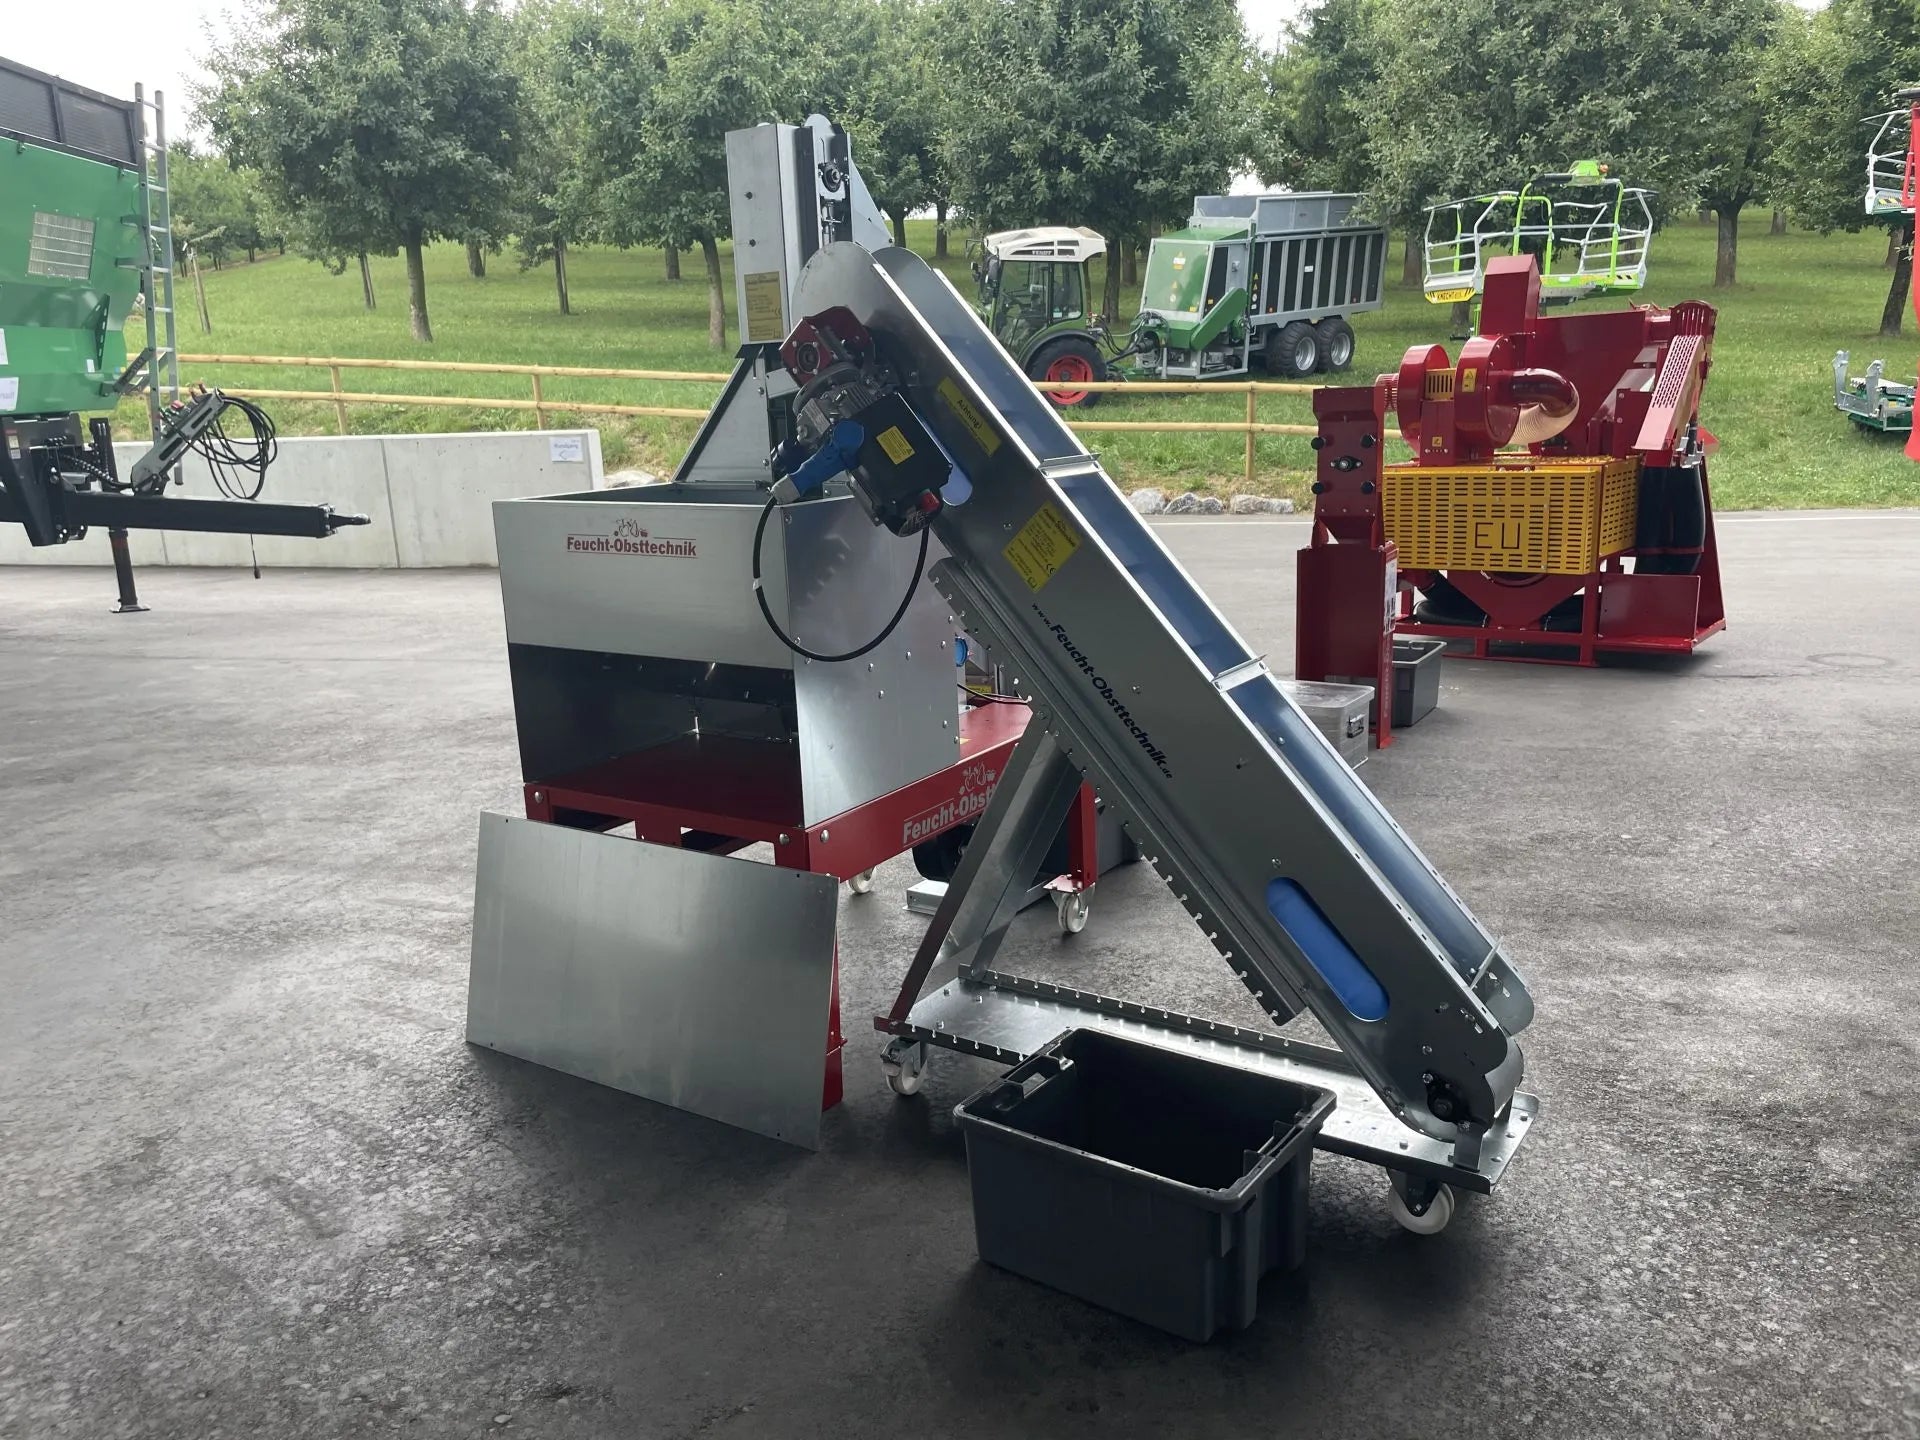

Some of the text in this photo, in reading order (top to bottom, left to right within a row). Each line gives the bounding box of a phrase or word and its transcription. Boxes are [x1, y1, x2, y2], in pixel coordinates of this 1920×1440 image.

[567, 536, 697, 556] Feucht-Obsttechnik
[1475, 522, 1521, 549] EU
[1031, 603, 1173, 779] www.Feucht-Obsttechnik.de
